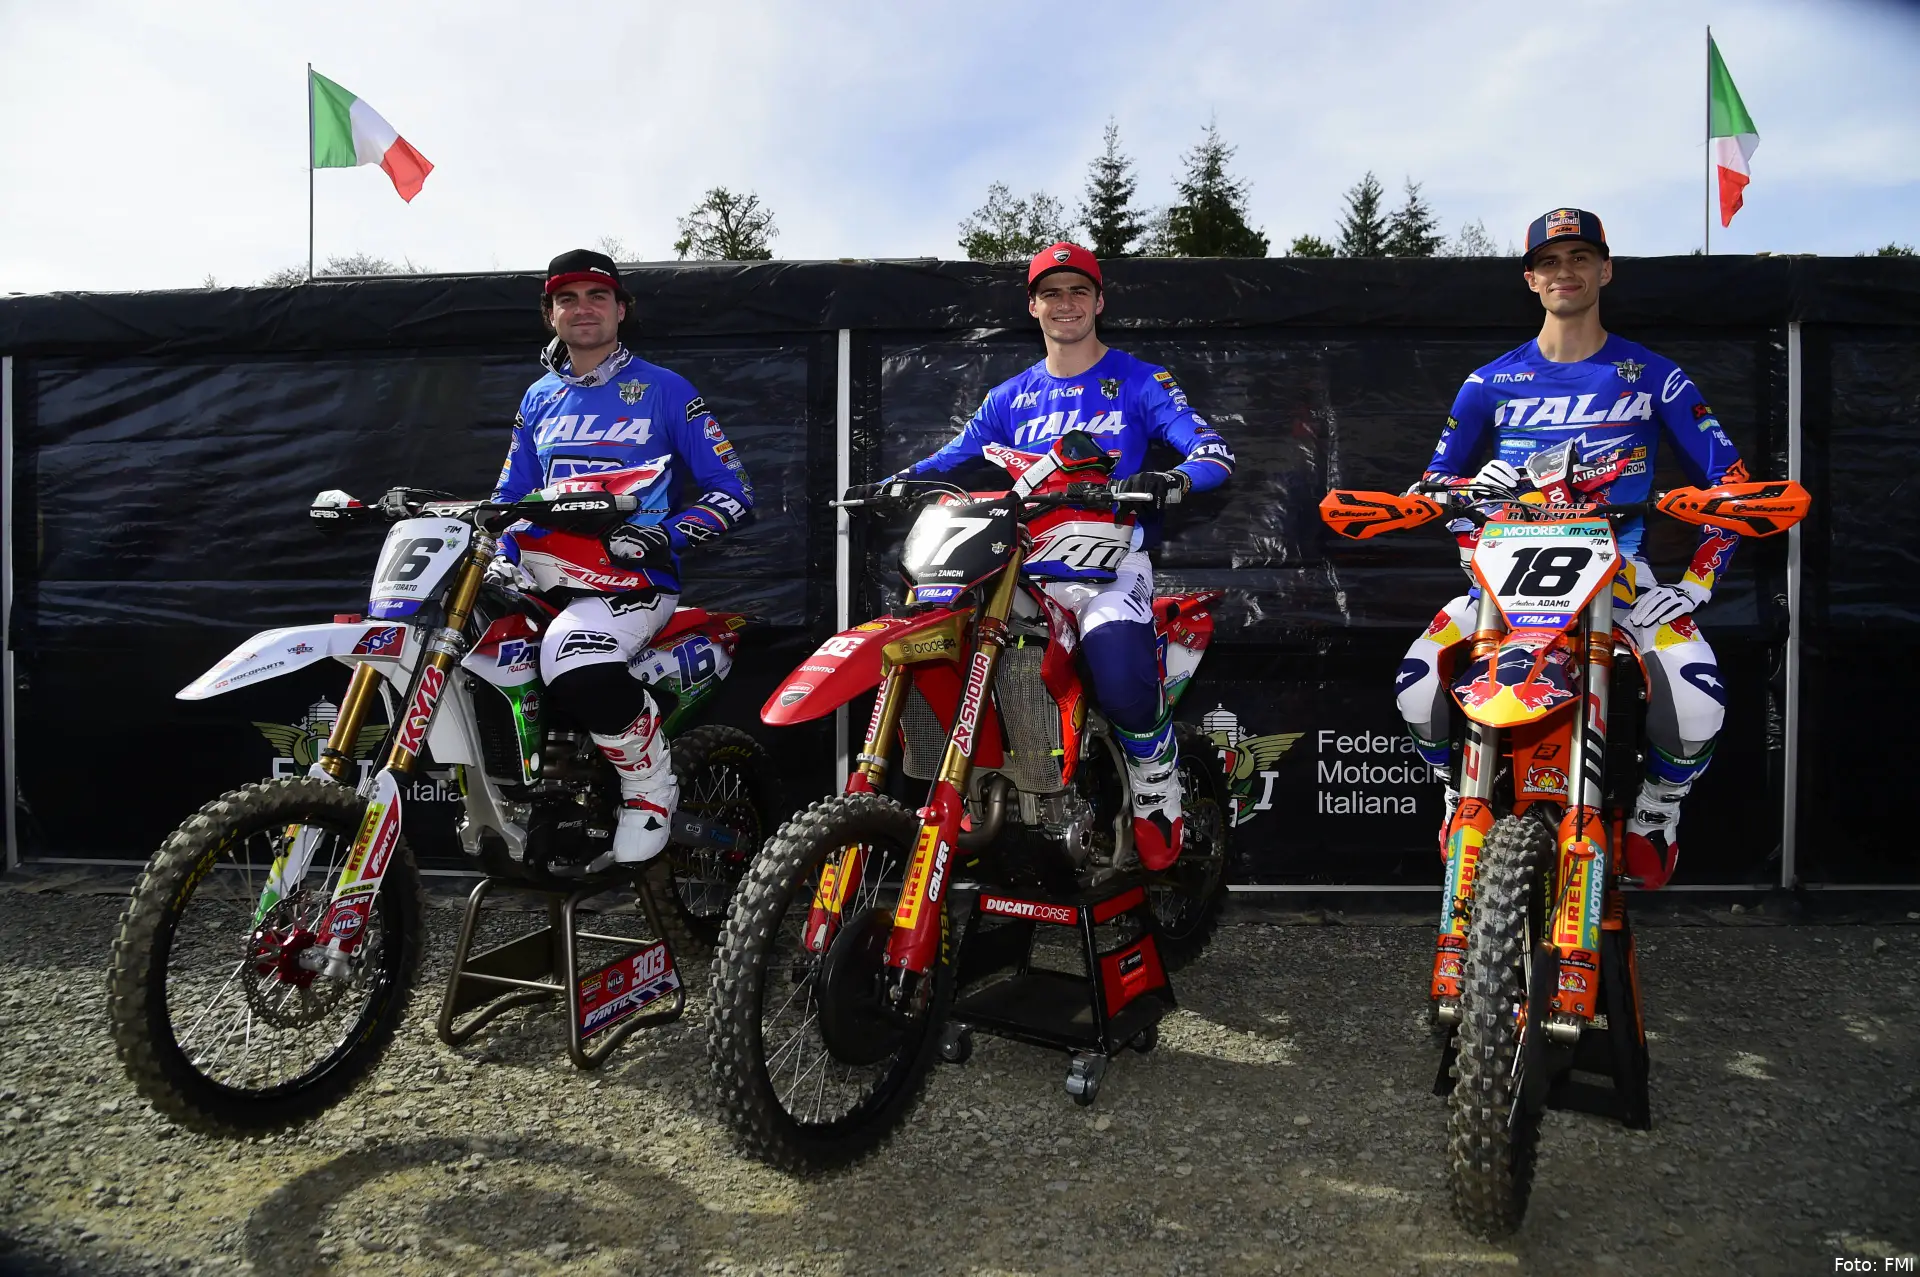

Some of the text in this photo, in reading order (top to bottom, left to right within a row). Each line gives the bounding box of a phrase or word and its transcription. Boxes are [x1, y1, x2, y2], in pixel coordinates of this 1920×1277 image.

[1494, 392, 1653, 427] ITALIA
[1014, 409, 1127, 446] ITALIA
[1572, 463, 1617, 484] AIROH
[551, 501, 609, 512] ACERBIS
[988, 508, 1009, 517] FIM
[1503, 525, 1565, 537] MOTOREX
[378, 538, 444, 583] 16
[1497, 547, 1593, 597] 18
[580, 572, 640, 588] ITALIA
[919, 588, 954, 597] ITALIA
[1516, 615, 1562, 624] ITALIA
[1537, 600, 1570, 608] ADAMO
[671, 635, 713, 693] 16
[521, 700, 540, 713] NILS
[961, 653, 990, 727] SHOWA
[399, 664, 445, 757] KYB
[1673, 757, 1696, 765] ITALY
[1318, 791, 1417, 813] Italiana
[371, 820, 397, 874] FANTIC
[898, 833, 931, 918] PIRELLI
[929, 841, 950, 901] GALFER
[1440, 860, 1455, 929] MOTOREX
[1589, 852, 1605, 925] MOTOREX
[331, 917, 361, 933] NILS
[608, 974, 625, 989] NILS
[632, 945, 665, 987] 303
[584, 996, 630, 1029] FANTIC
